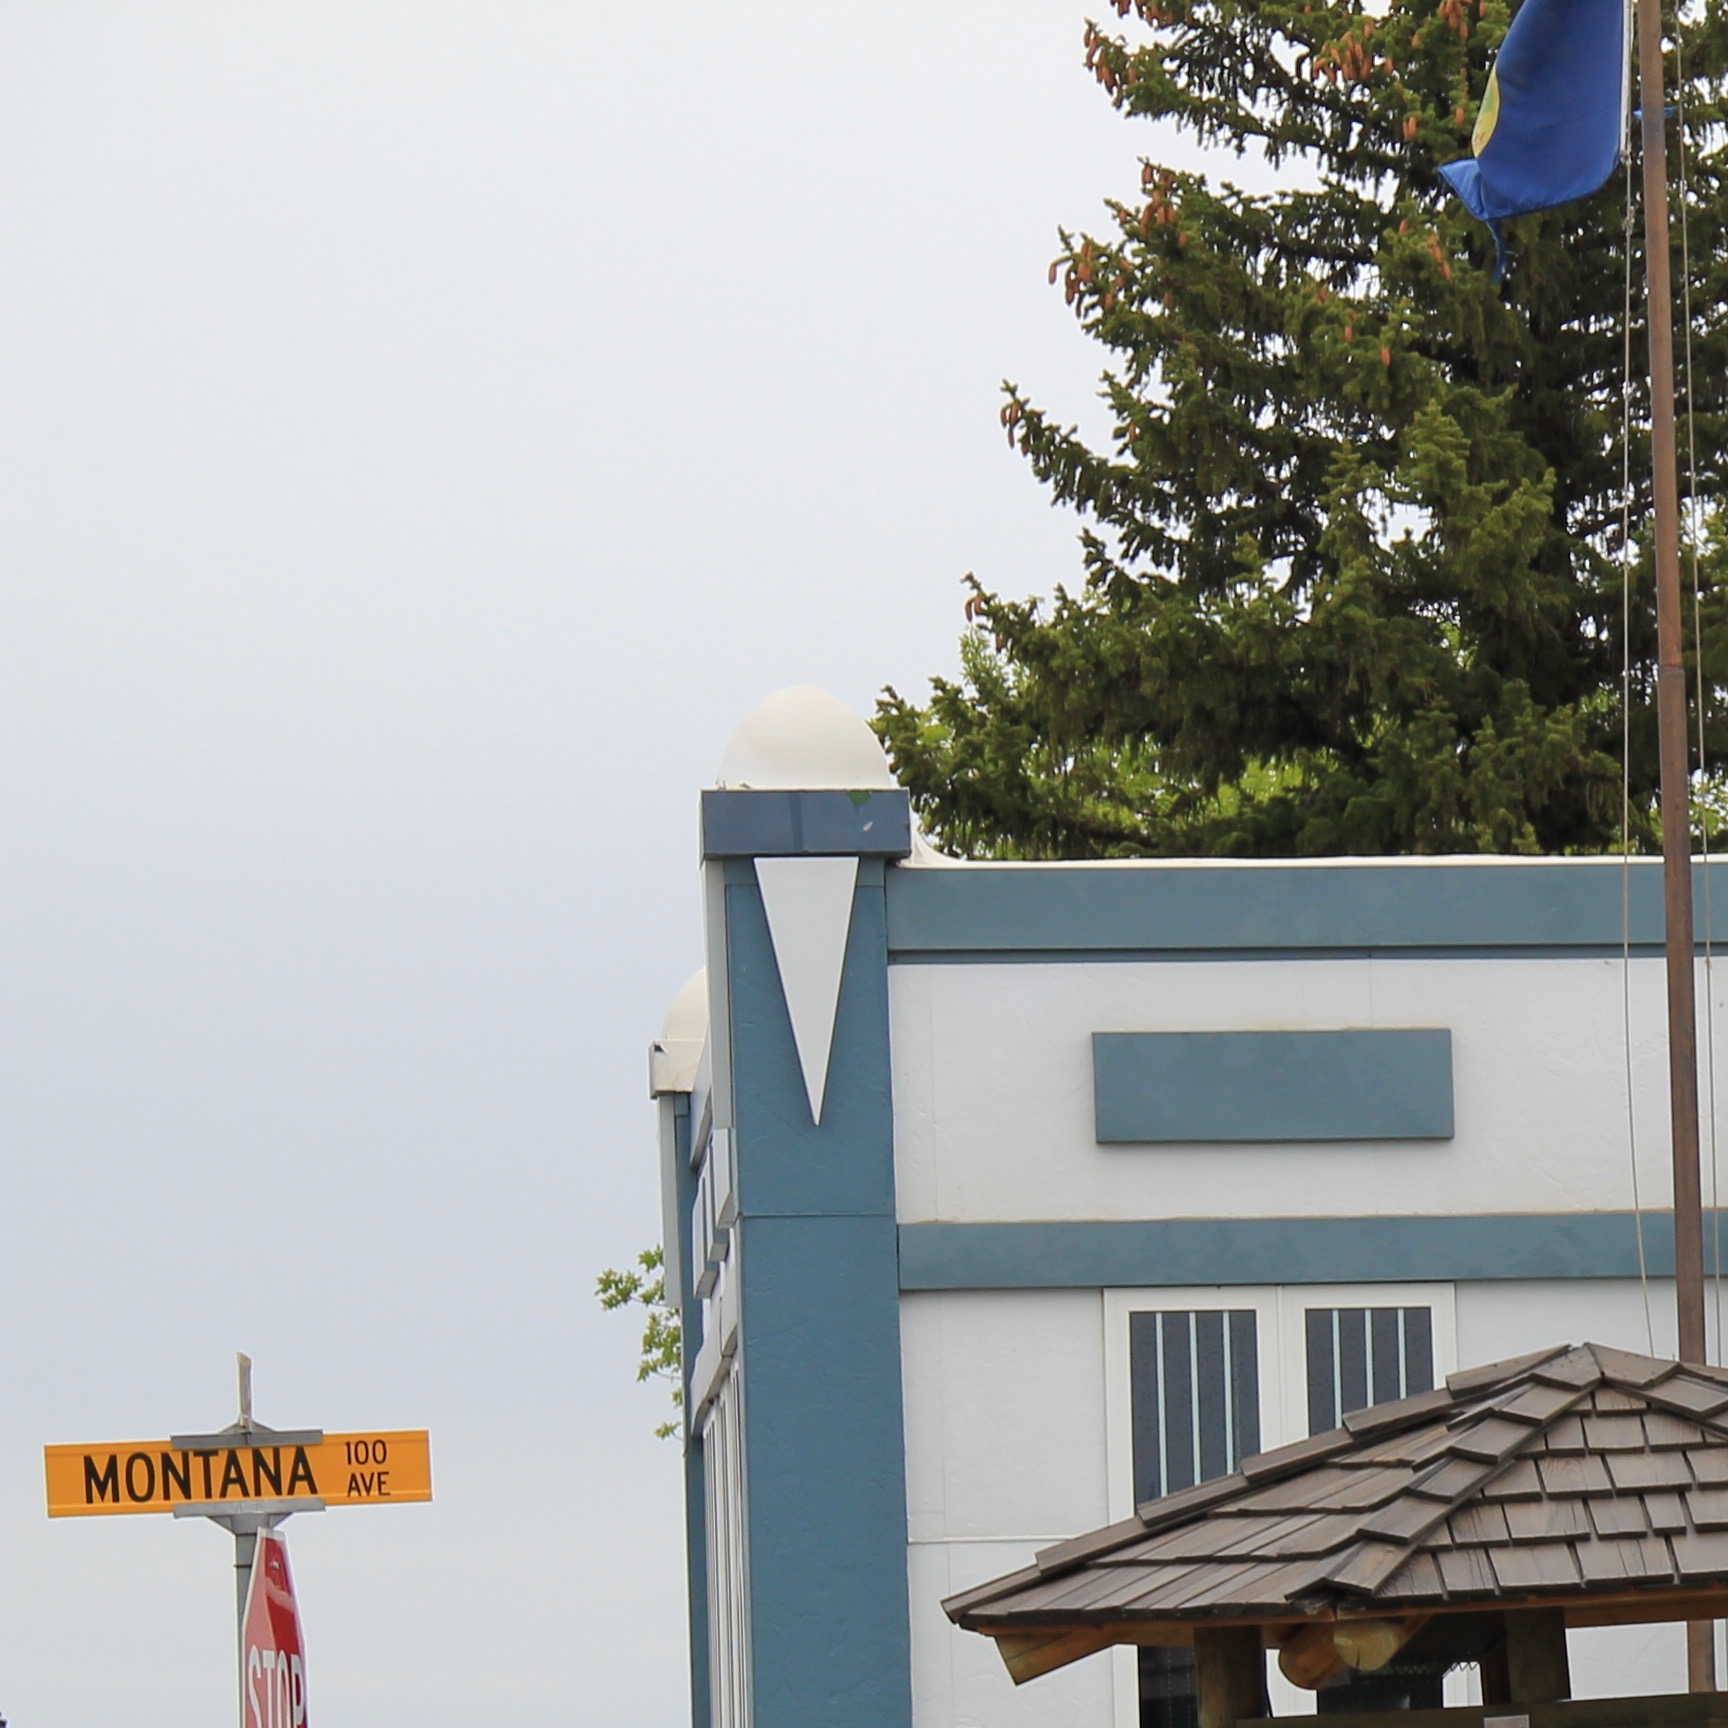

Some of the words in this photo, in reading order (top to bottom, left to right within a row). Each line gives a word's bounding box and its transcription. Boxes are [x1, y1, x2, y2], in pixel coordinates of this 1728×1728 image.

[83, 1445, 319, 1504] MONTANA
[345, 1439, 388, 1466] 100
[347, 1471, 391, 1498] AVE
